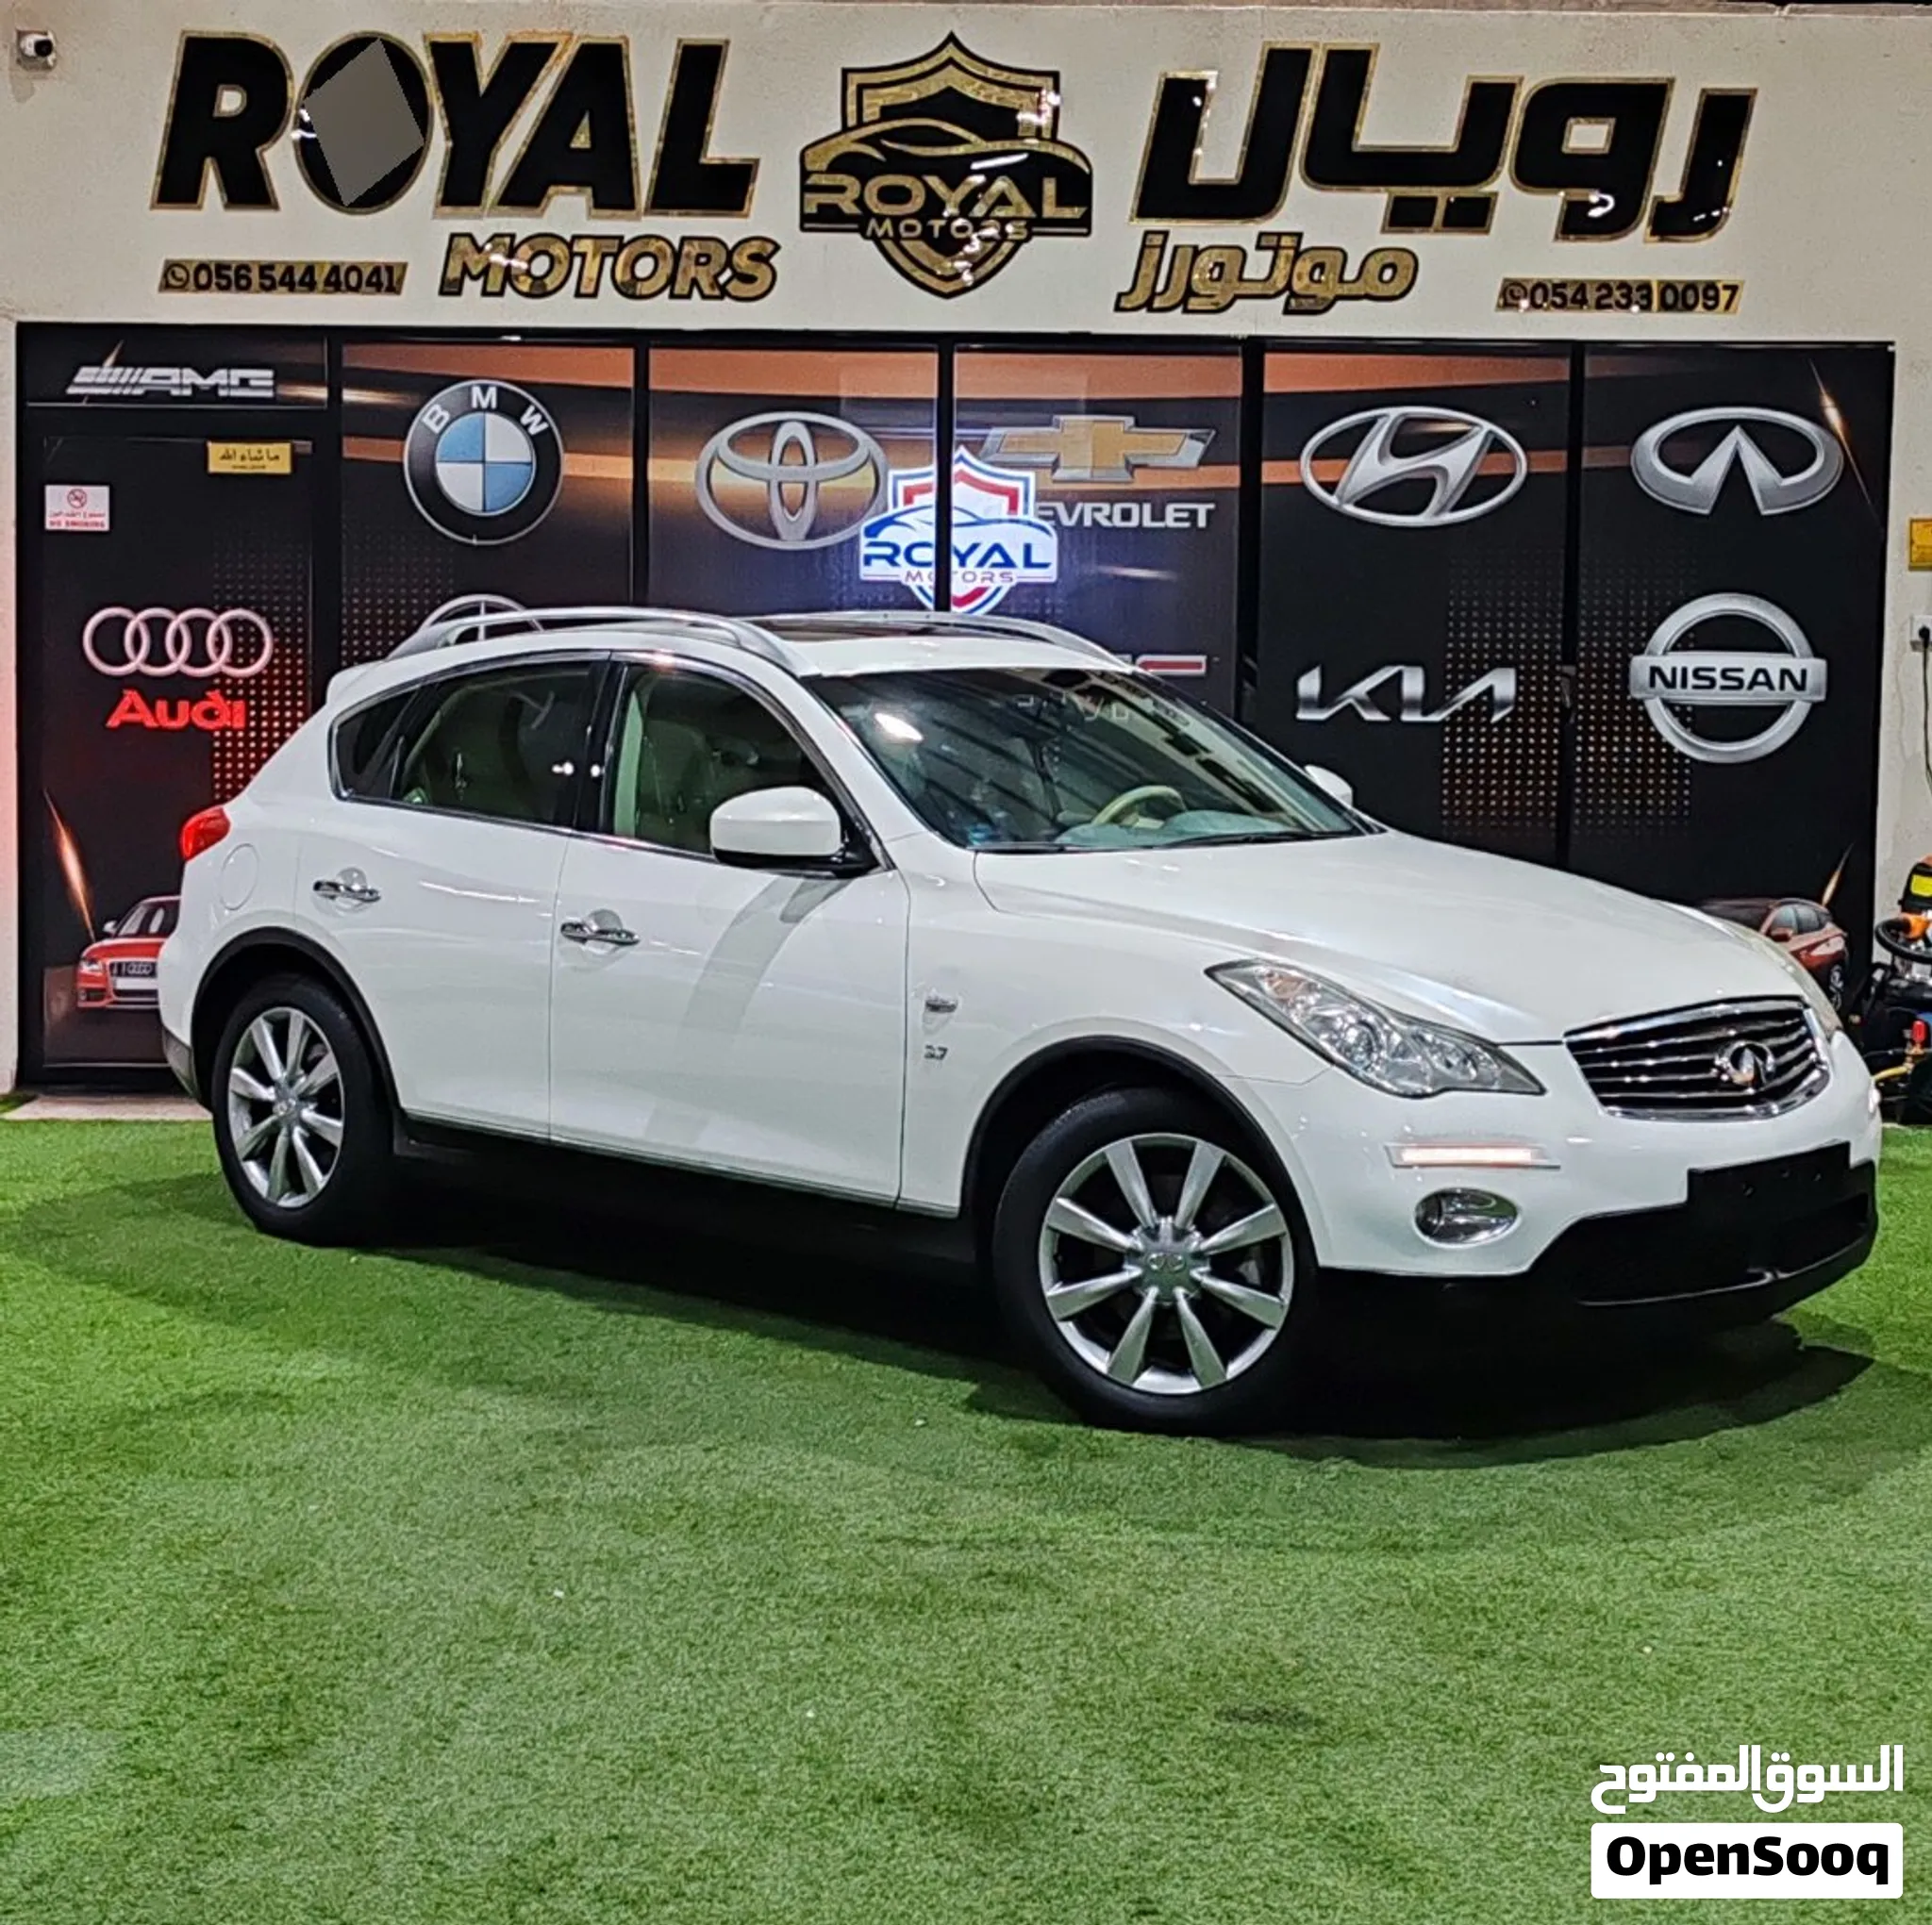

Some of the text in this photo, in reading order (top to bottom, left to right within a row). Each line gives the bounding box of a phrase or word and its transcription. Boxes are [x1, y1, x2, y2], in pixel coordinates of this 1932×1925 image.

[1128, 41, 1758, 242] رويال
[804, 174, 1089, 219] ROYAL
[866, 218, 1028, 238] MOTORS
[193, 262, 397, 294] 056 544 4041
[439, 233, 779, 301] MOTORS
[1114, 229, 1420, 315] موتورز
[1529, 282, 1740, 312] 054 233 0097
[140, 366, 275, 398] AMG
[421, 385, 550, 437] BMW
[1033, 501, 1216, 529] EVROLET
[905, 570, 1014, 584] MORS
[1296, 665, 1517, 724] KIA
[1648, 665, 1808, 692] NISSAN
[106, 689, 246, 730] Audi
